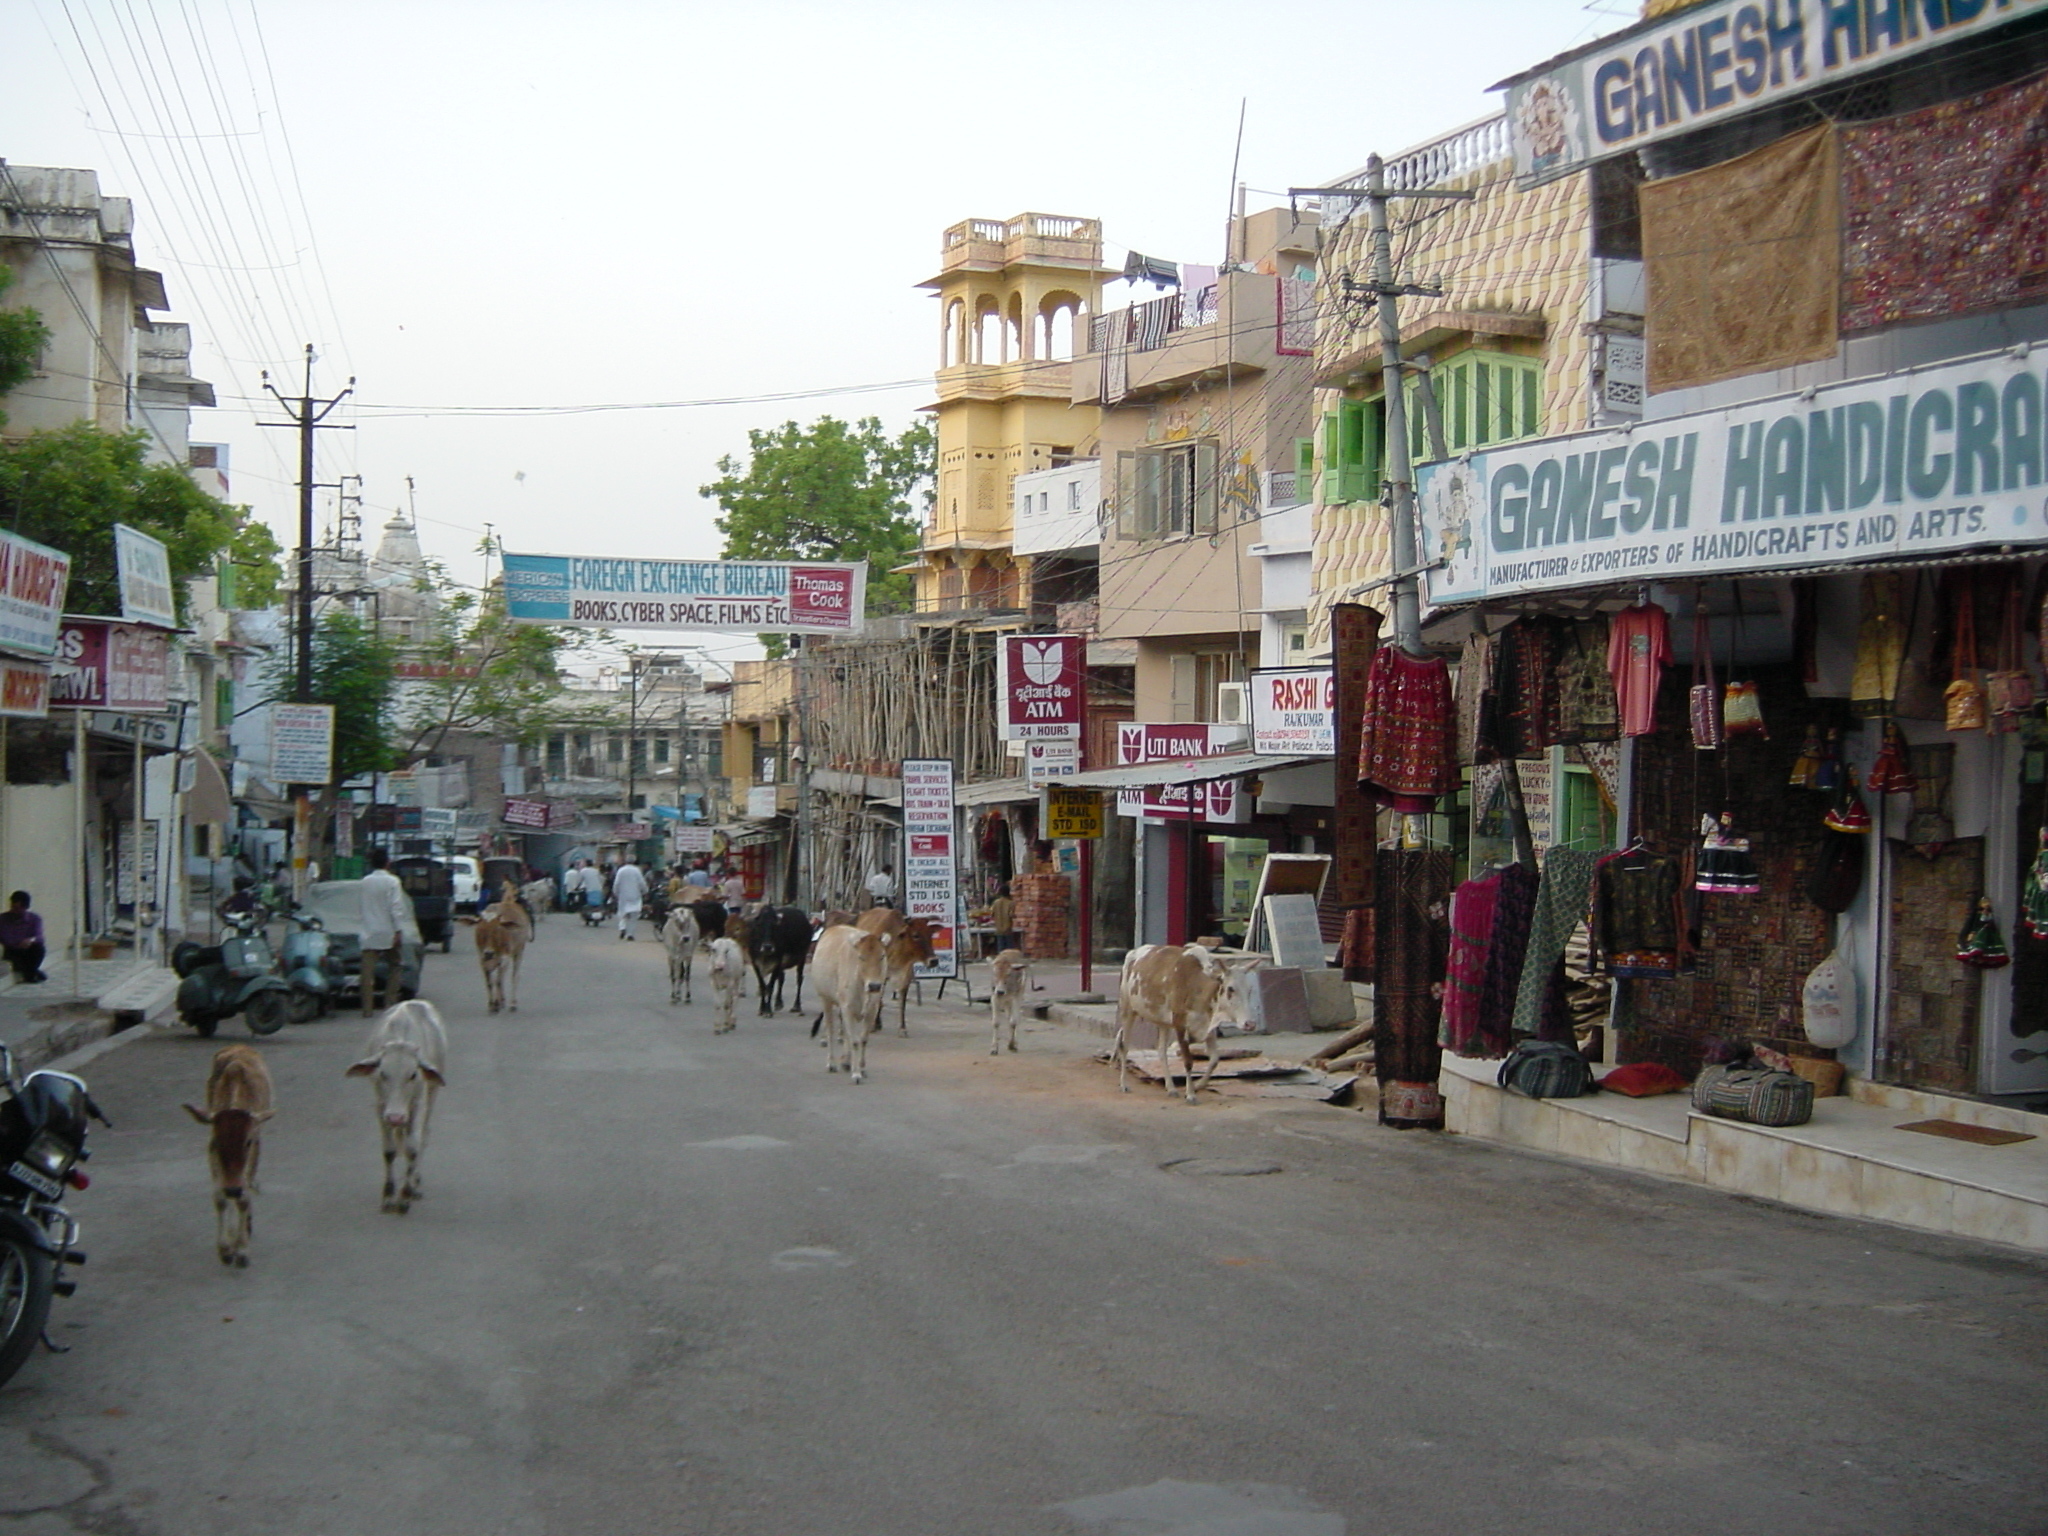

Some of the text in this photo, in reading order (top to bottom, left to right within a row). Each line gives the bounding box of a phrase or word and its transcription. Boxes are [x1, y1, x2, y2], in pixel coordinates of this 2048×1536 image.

[1594, 0, 1808, 147] GANESH
[1490, 369, 2048, 555] GANESH HANDICRA
[1489, 557, 1568, 585] MANUFACTURER
[1581, 545, 1659, 573] EXPORTERS
[1666, 542, 1684, 563] OF
[1691, 521, 1849, 562] HANDICRAFTS
[1854, 514, 1896, 547] AND
[1907, 505, 1987, 541] ARTS.
[573, 559, 786, 596] FOREIGN EXCHANGE BUREAU
[795, 576, 844, 592] Thomas
[809, 592, 843, 608] Cook
[1272, 678, 1317, 710] RASHI
[1025, 701, 1063, 718] ATM
[1284, 712, 1324, 727] RAJKUMAR
[112, 717, 166, 740] ARTS
[1020, 725, 1069, 736] 24 HOURS
[1147, 738, 1166, 755] UTI
[1170, 738, 1203, 757] BANK
[1521, 763, 1550, 774] PRECIOUS
[1522, 776, 1545, 789] LUCKY
[906, 787, 925, 796] FLIGHT
[1049, 790, 1099, 805] INTERNET
[1119, 789, 1141, 804] ATM
[908, 812, 948, 820] RESERVATION
[1057, 806, 1091, 818] E-MAIL
[1053, 819, 1097, 830] STD ISD
[908, 890, 950, 900] STD ISD
[913, 903, 945, 914] BOOKS
